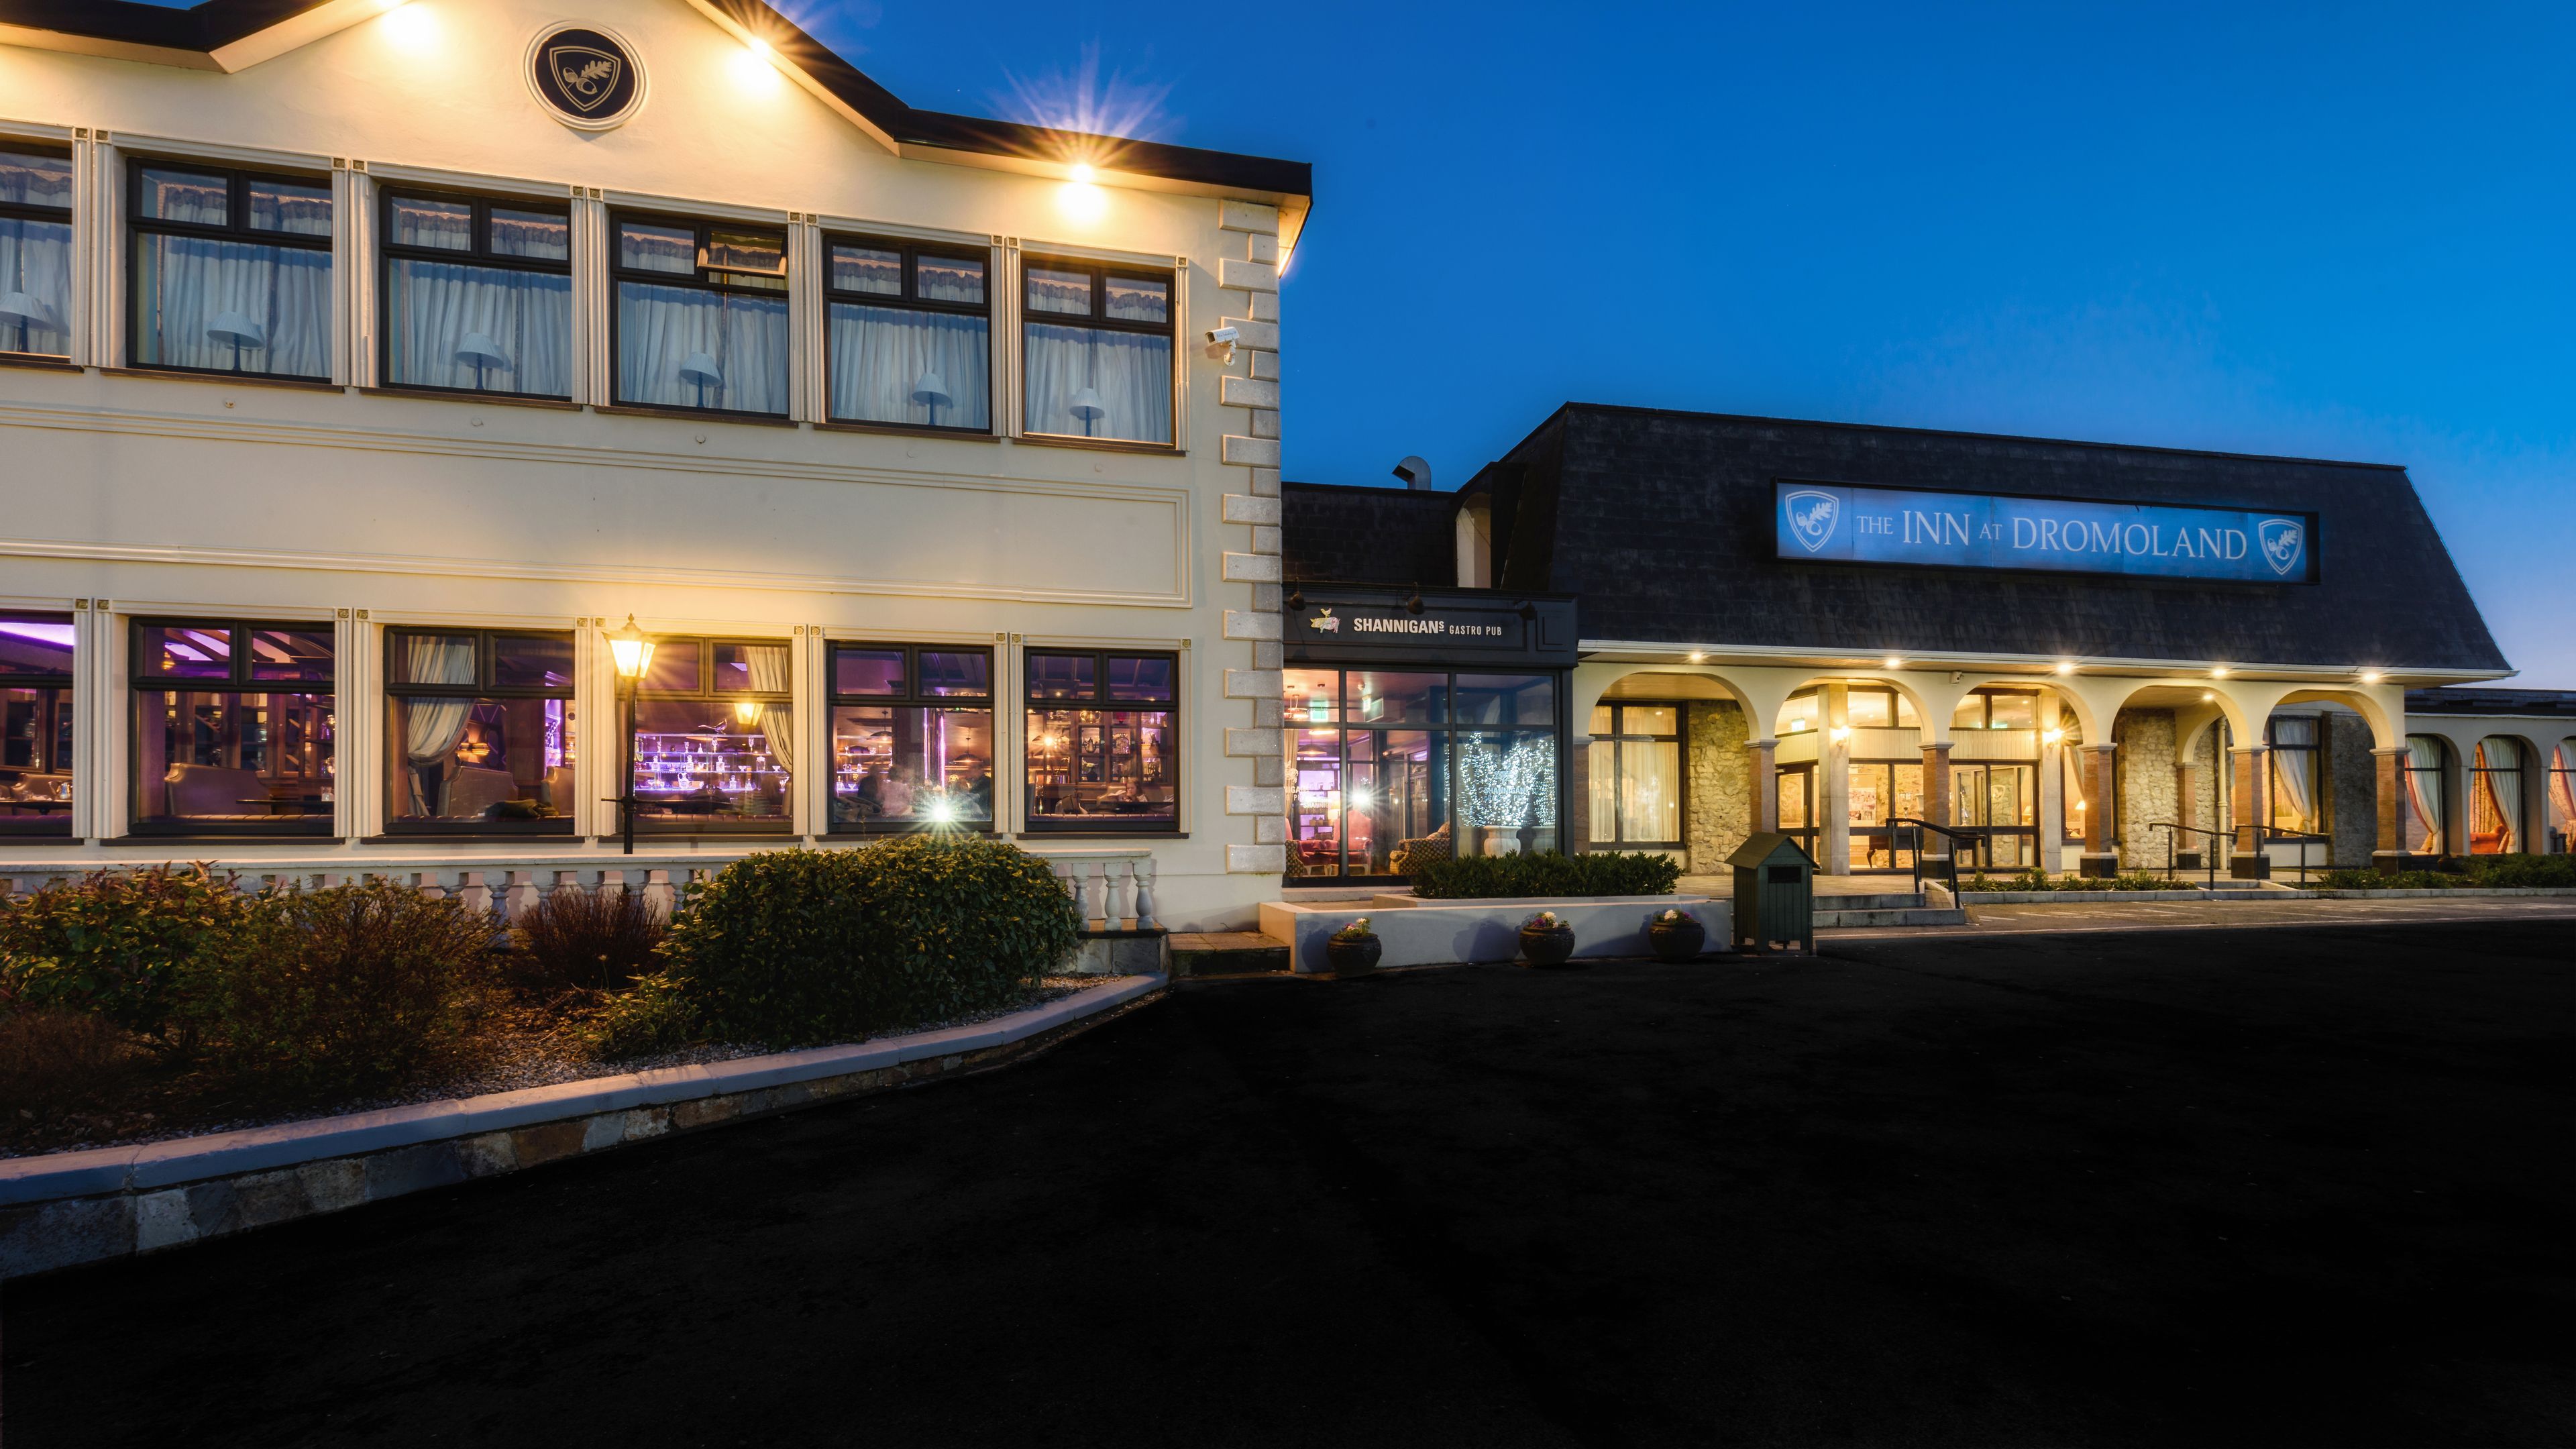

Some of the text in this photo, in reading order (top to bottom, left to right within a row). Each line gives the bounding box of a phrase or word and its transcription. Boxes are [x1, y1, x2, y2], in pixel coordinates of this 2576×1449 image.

[1856, 510, 2247, 559] THE INN AT DROMOLAND
[1449, 625, 1481, 635] GASTRO
[1486, 626, 1502, 636] PUB
